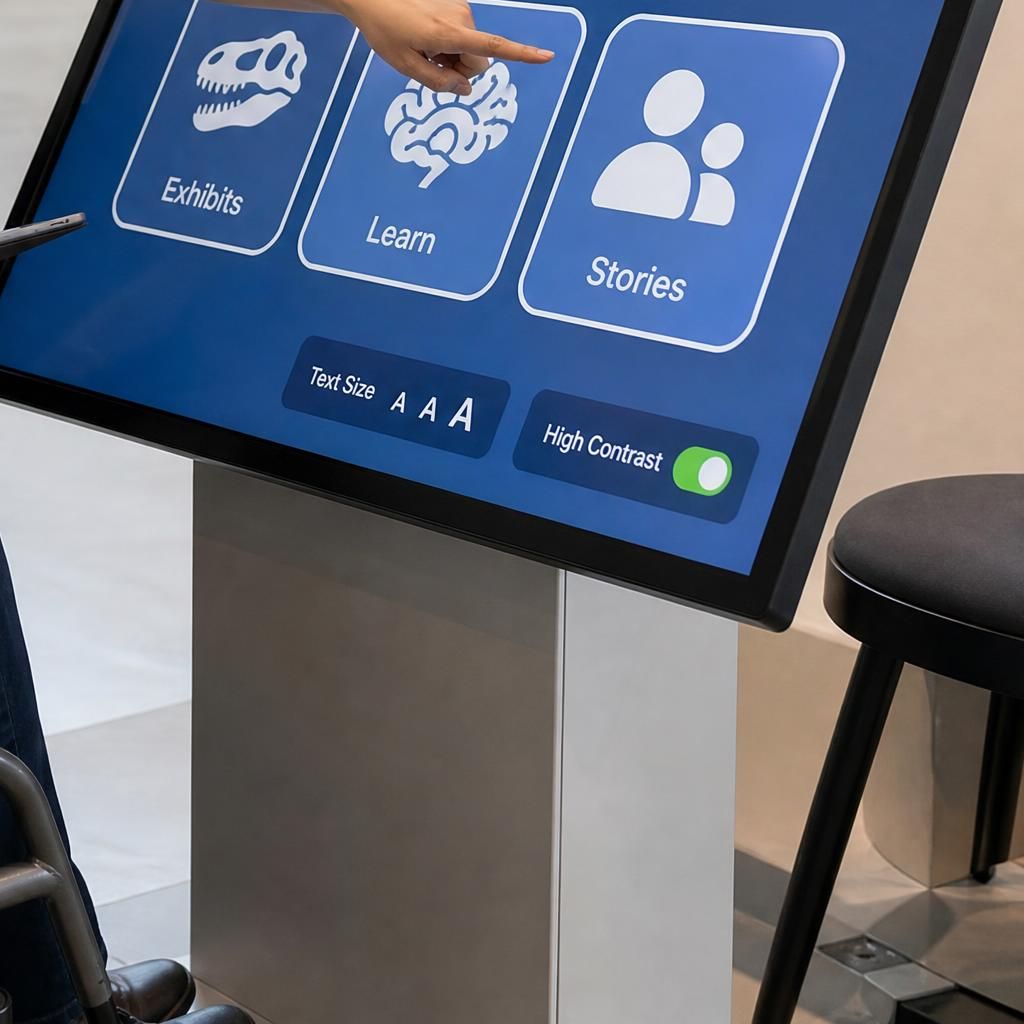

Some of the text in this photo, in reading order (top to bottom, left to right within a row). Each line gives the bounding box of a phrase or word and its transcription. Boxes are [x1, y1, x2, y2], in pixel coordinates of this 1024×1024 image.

[161, 176, 244, 216] Exhibits
[366, 216, 436, 255] Learn
[586, 255, 687, 303] Stories
[310, 366, 474, 432] Text Size A A A
[542, 423, 663, 472] High Contrast
